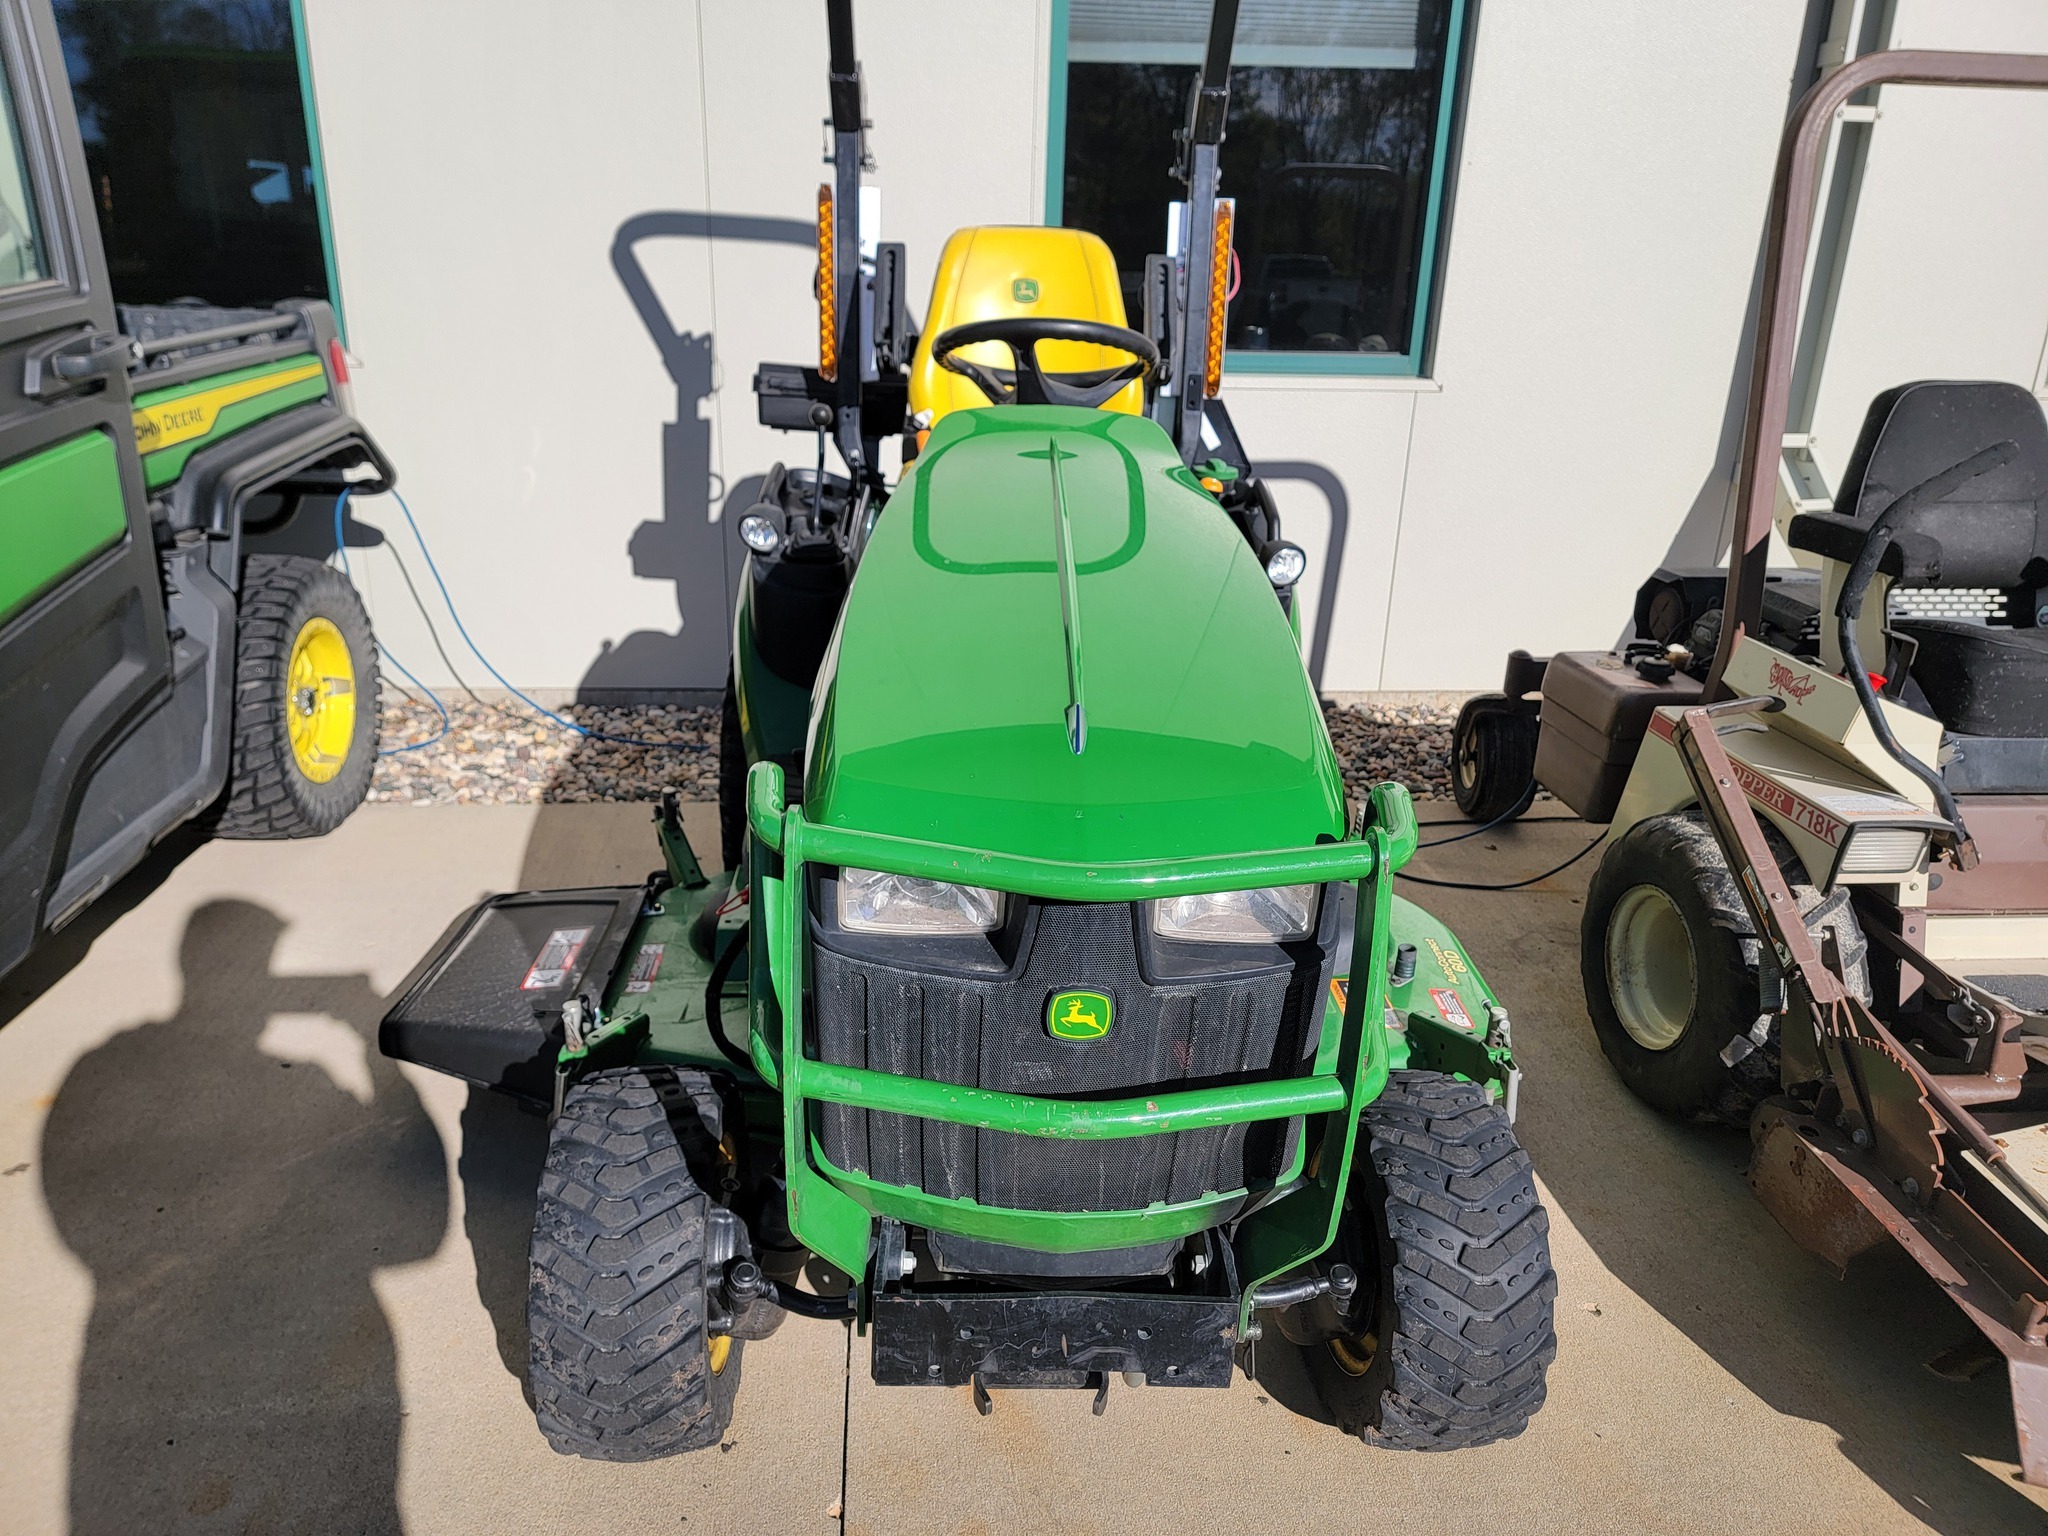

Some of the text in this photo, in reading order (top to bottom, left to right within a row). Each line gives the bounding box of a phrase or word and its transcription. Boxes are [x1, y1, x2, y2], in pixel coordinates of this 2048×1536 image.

[135, 408, 203, 440] OHN DEERE
[1731, 764, 1786, 810] OPPER
[1795, 801, 1840, 845] 718K
[1442, 949, 1468, 973] 60D
